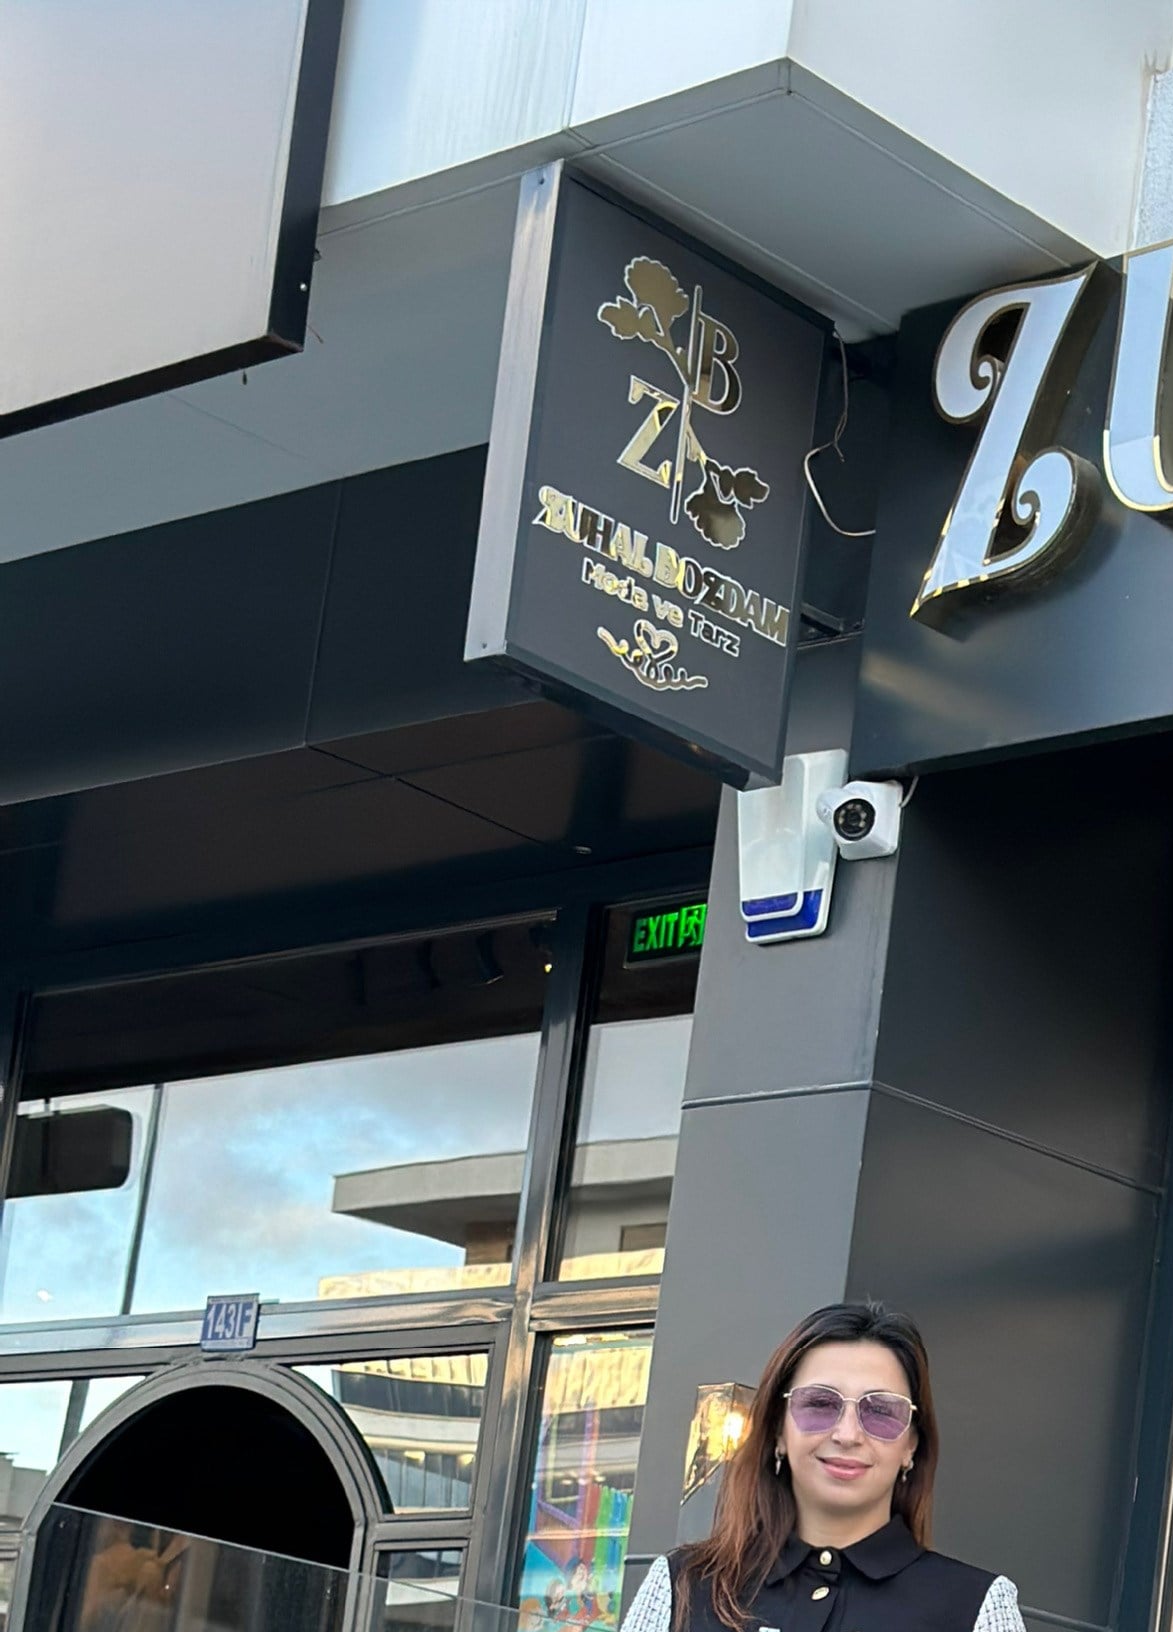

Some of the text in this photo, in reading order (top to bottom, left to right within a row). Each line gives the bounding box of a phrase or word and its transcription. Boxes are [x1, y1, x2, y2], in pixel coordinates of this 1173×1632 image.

[690, 311, 742, 415] B
[617, 375, 681, 489] Z
[532, 485, 653, 578] ZUHAL
[582, 557, 741, 657] Moda ve Tarz
[633, 912, 679, 953] EXIT
